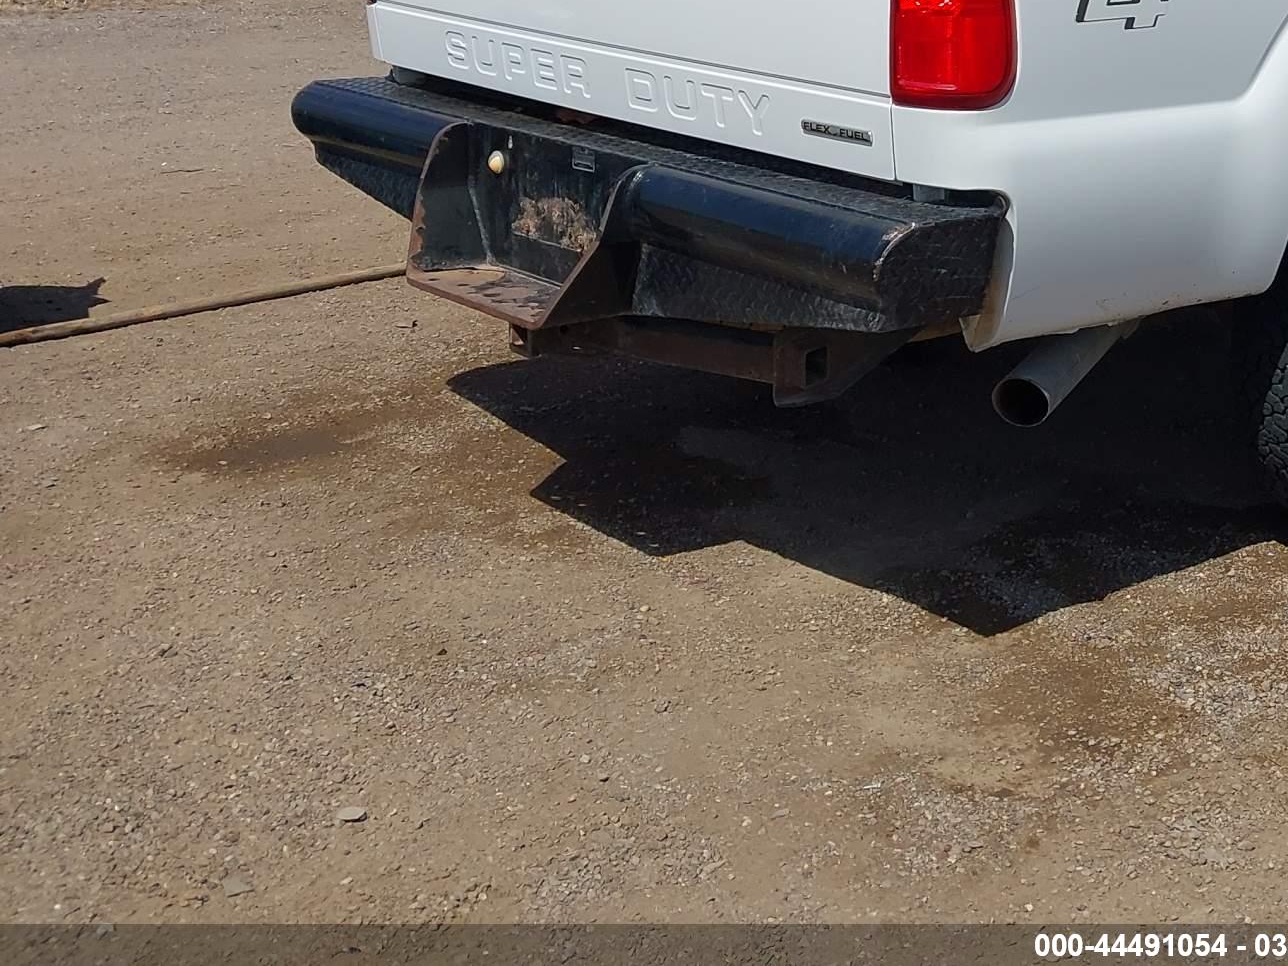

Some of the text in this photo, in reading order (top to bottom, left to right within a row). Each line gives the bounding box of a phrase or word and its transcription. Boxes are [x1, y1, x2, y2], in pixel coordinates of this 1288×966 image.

[446, 30, 769, 136] SUPER DUTY
[803, 120, 869, 142] FLEX FUEL
